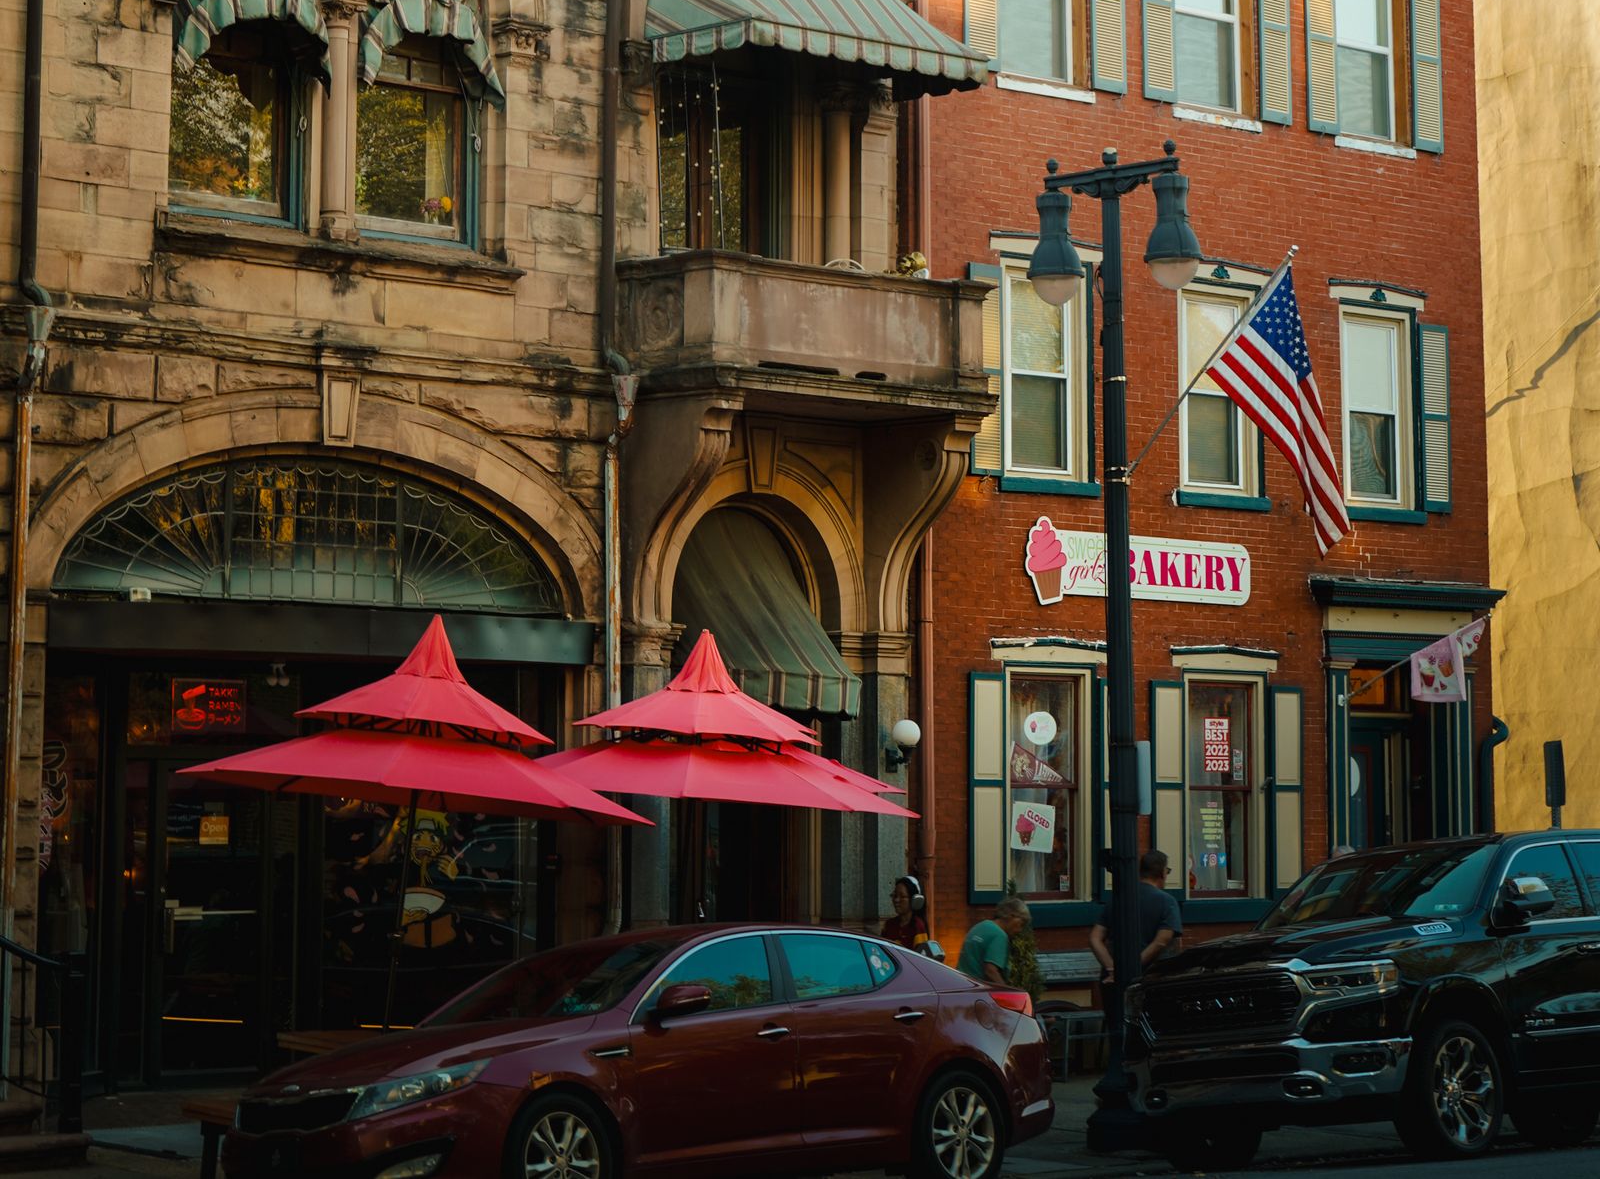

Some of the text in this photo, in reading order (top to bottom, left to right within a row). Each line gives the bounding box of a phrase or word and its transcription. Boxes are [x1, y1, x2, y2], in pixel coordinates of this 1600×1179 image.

[1068, 536, 1106, 561] swee
[208, 700, 241, 712] RAMEN
[208, 713, 241, 726] ラーメン
[1205, 729, 1229, 741] BEST
[1205, 744, 1229, 756] 2022
[1205, 760, 1230, 772] 2023
[1026, 810, 1050, 829] CLOSED
[201, 821, 227, 836] Open
[1525, 1018, 1555, 1027] RAM
